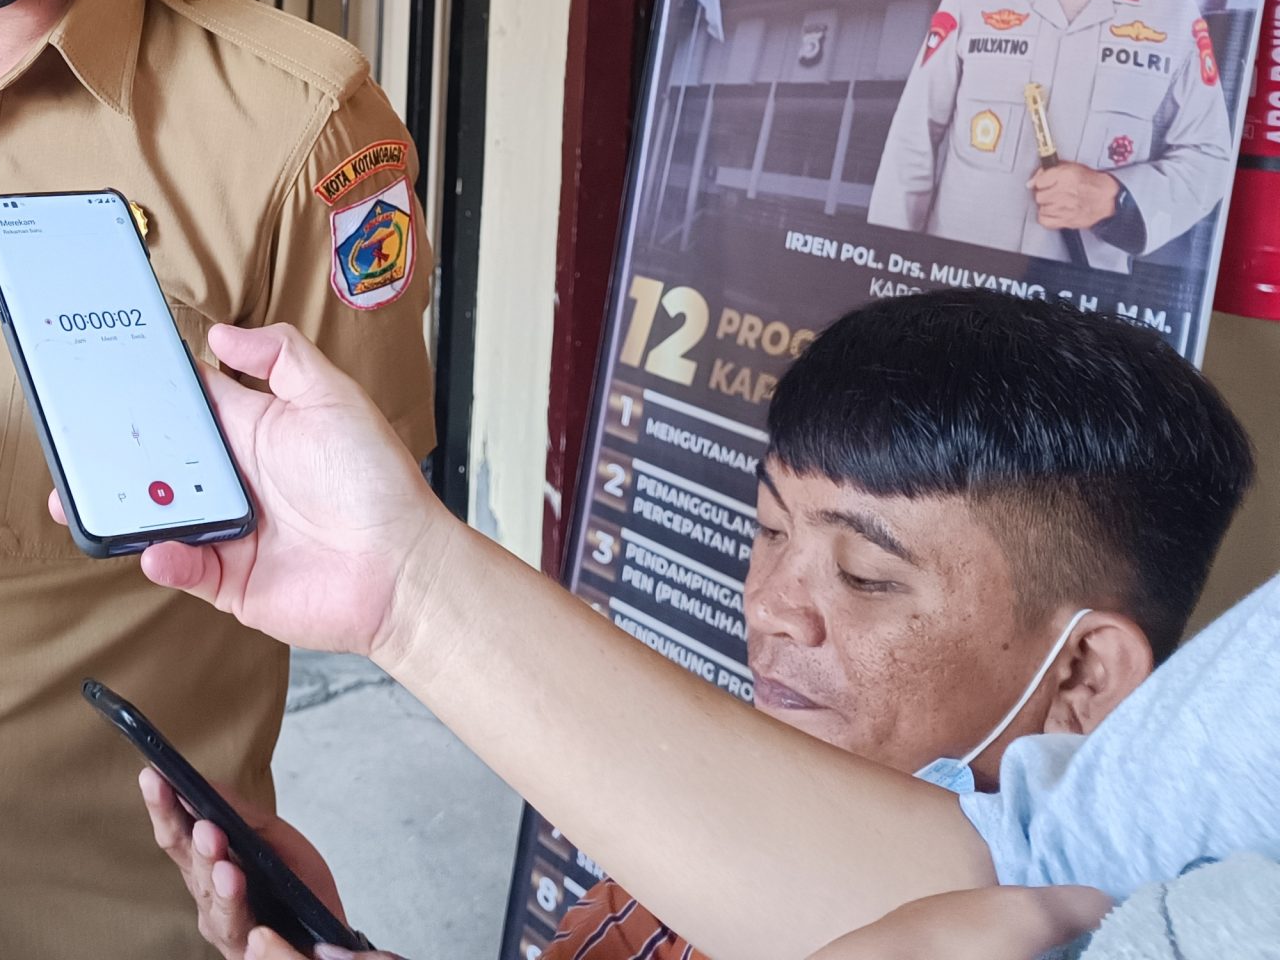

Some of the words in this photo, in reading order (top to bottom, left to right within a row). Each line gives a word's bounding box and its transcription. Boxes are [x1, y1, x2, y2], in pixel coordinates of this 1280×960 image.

[968, 37, 1029, 56] MULYATNO
[1101, 47, 1172, 74] POLRI
[323, 170, 350, 198] KOTA
[0, 219, 36, 227] Merekam
[785, 230, 837, 259] IRJEN
[840, 241, 883, 269] POL.
[887, 254, 924, 279] Drs.
[59, 308, 147, 332] 00:00:02
[620, 274, 709, 386] 12
[620, 395, 634, 427] 1
[646, 417, 760, 477] MENGUTAMAK
[603, 463, 626, 497] 2
[632, 496, 736, 558] PERCEPATAN
[592, 530, 616, 565] 3
[625, 543, 746, 612] PENDAMPINGA
[622, 565, 654, 596] PEN
[655, 580, 749, 642] (PEMULIHA
[716, 669, 754, 705] PRO
[536, 876, 560, 912] 8
